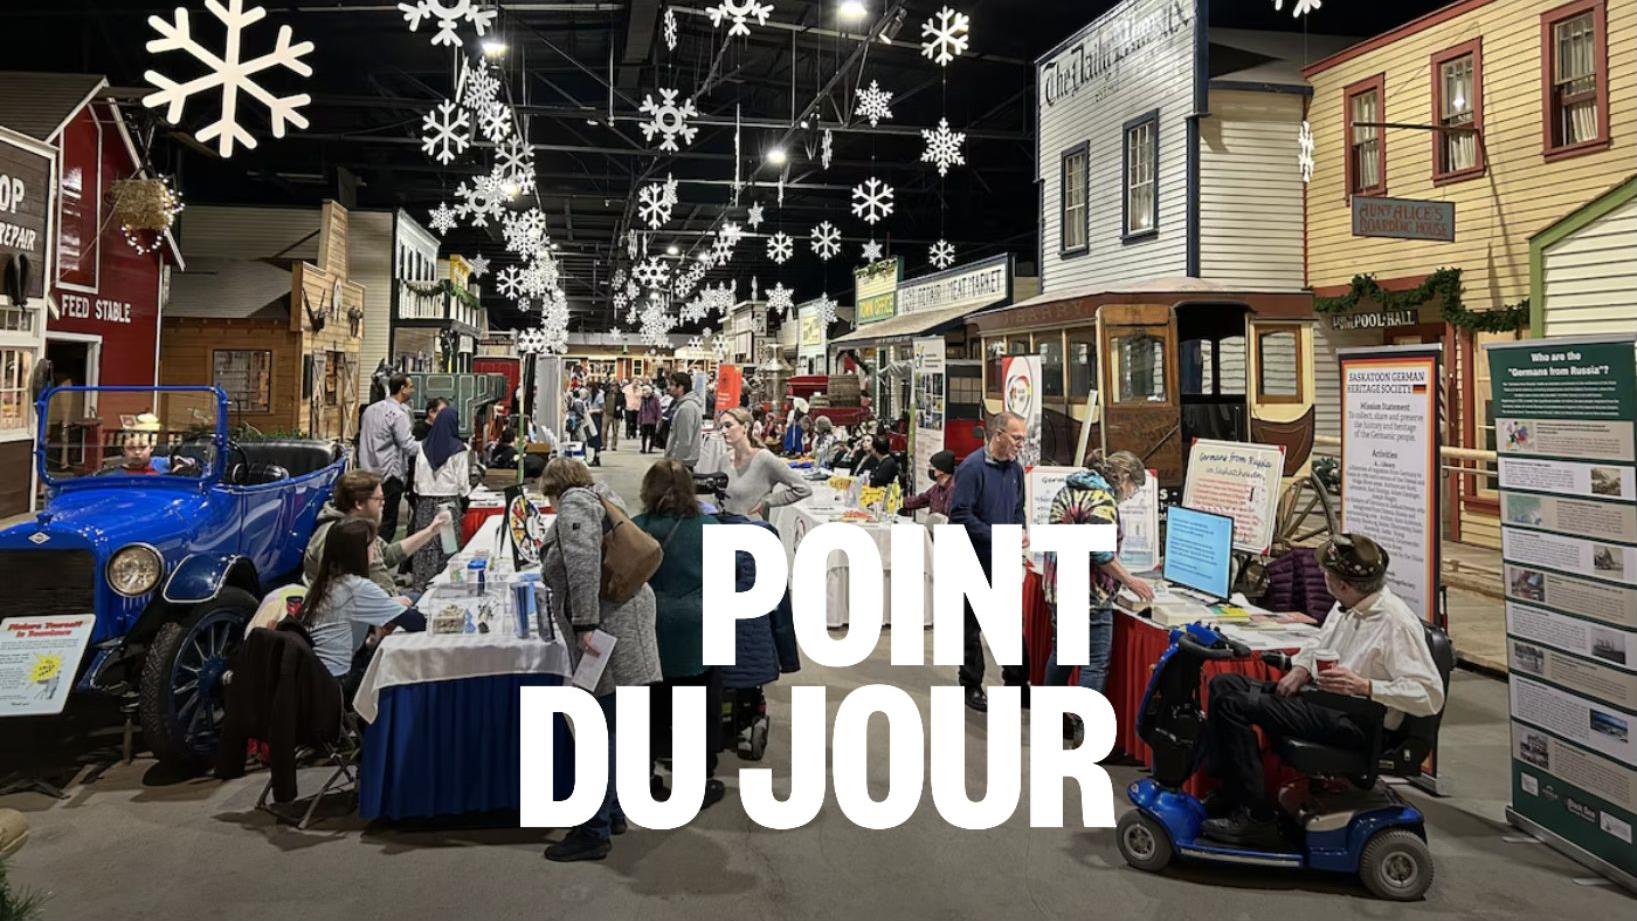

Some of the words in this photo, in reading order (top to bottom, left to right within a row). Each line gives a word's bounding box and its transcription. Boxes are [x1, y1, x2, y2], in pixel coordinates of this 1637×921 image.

[1360, 202, 1391, 217] AUNT
[1360, 218, 1413, 234] BOARDING
[1416, 222, 1449, 237] HOUSE
[968, 269, 1002, 297] MARKET
[62, 295, 90, 318] FEED
[95, 299, 131, 323] STABLE
[1387, 310, 1416, 327] HALL
[1530, 353, 1549, 362] Who
[1567, 352, 1581, 361] the
[1549, 366, 1569, 375] from
[1349, 372, 1391, 382] SASKATOON
[1392, 371, 1425, 382] GERMAN
[1347, 384, 1381, 394] HERITAGE
[1381, 384, 1412, 394] SOCIETY
[1360, 402, 1381, 410] Mission
[1382, 403, 1410, 411] Statement
[1229, 452, 1246, 463] from
[1372, 449, 1398, 459] Activities
